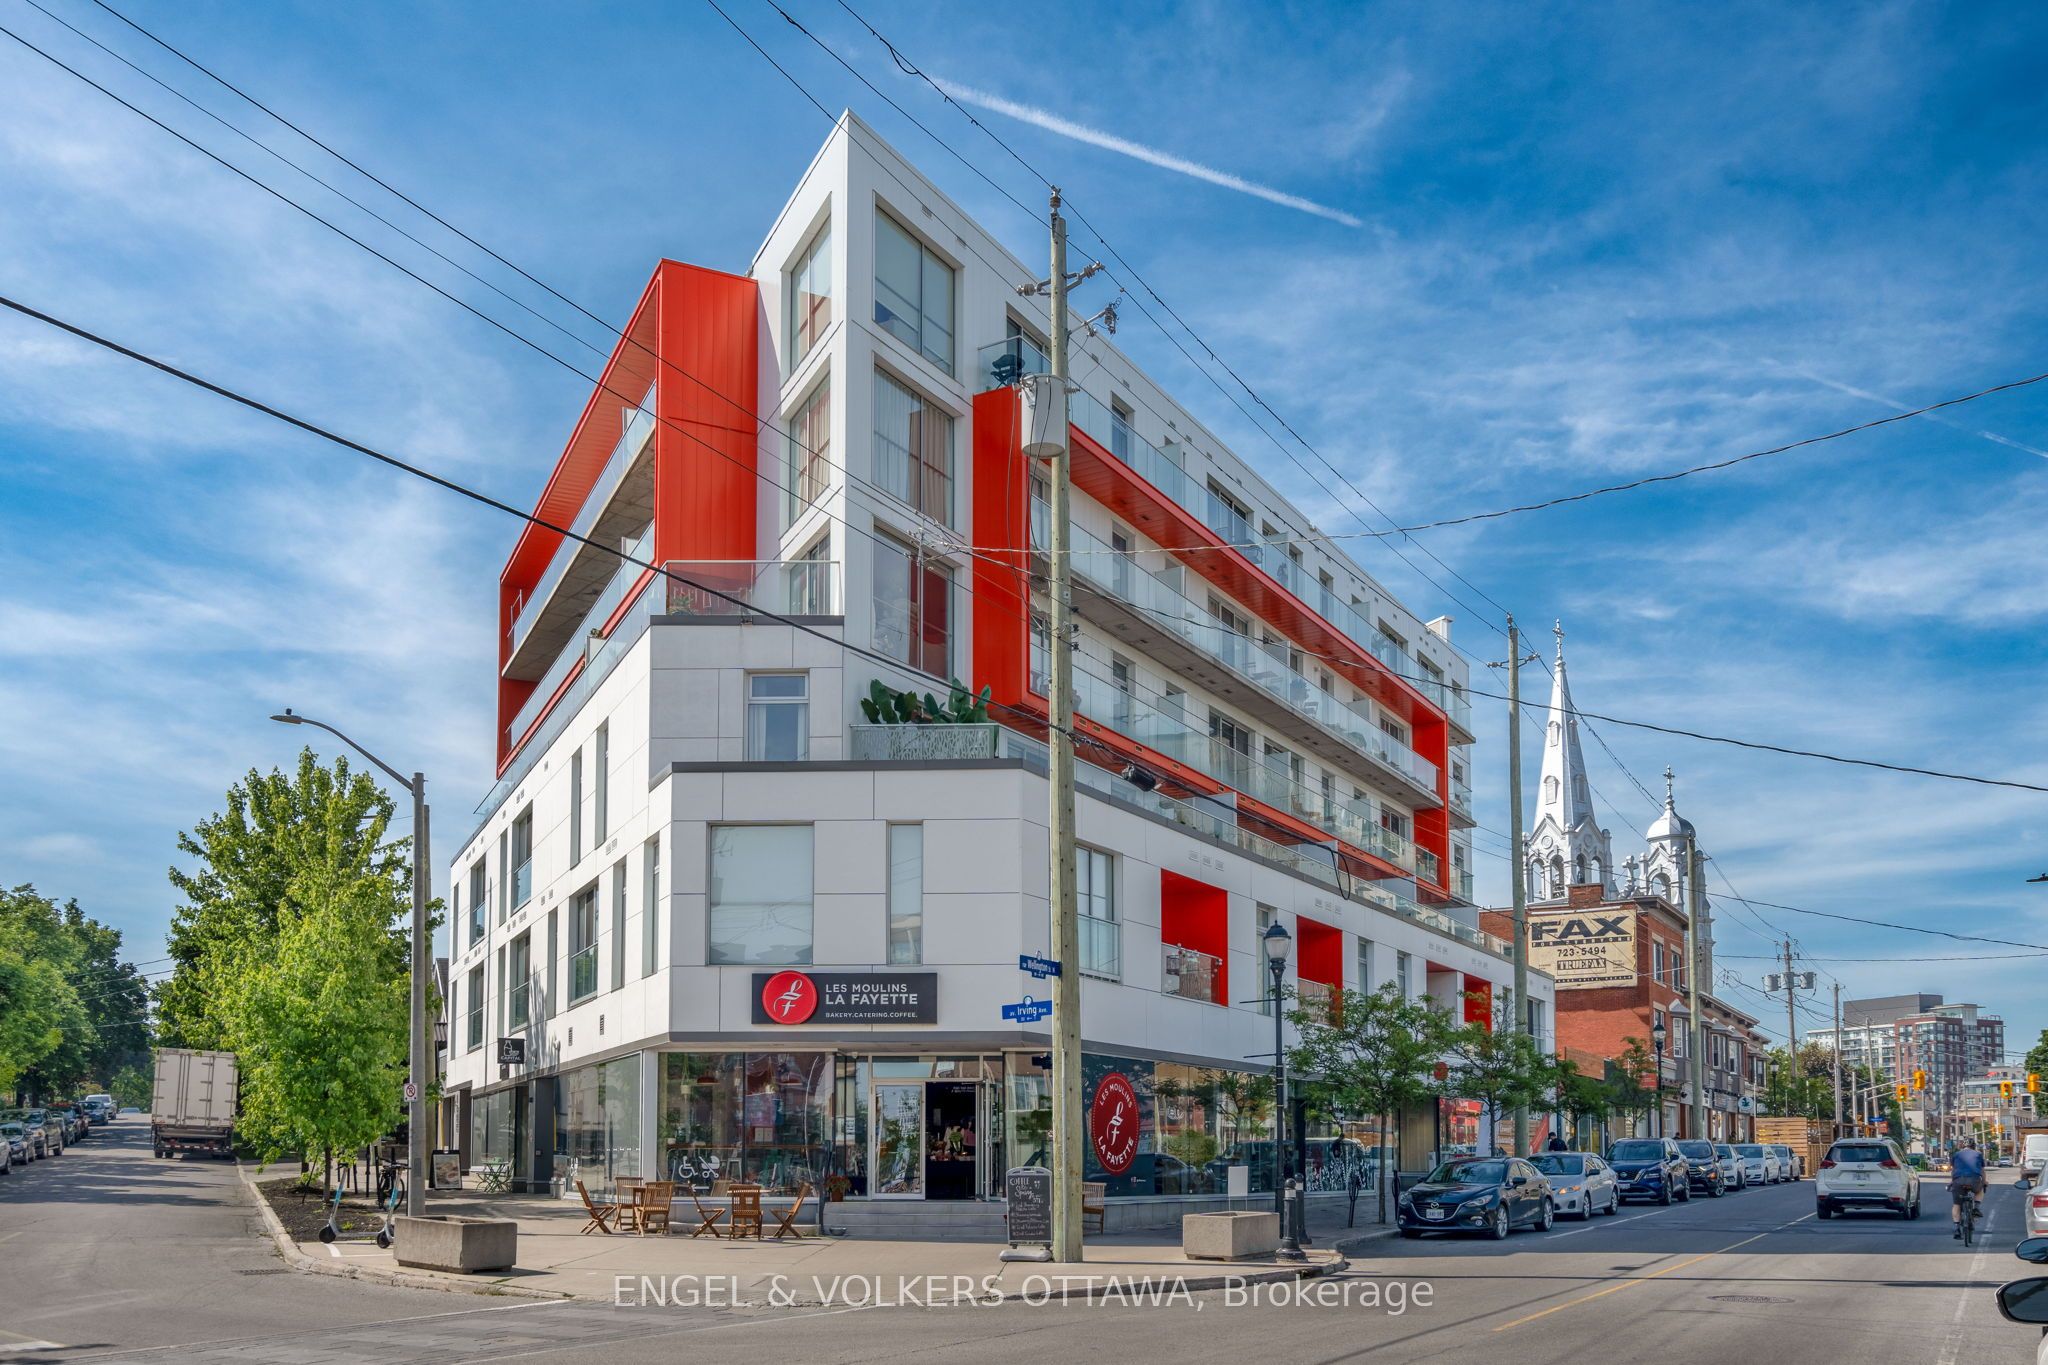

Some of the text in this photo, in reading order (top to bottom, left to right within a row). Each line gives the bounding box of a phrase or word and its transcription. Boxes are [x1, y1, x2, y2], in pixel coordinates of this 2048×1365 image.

[1532, 916, 1631, 940] FAX
[1557, 946, 1606, 957] 723-5494
[1557, 959, 1606, 970] TRUEFAX
[825, 984, 908, 993] LES MOULINS
[825, 994, 918, 1005] LA FAYETTE
[1017, 1006, 1037, 1017] Irving
[1100, 1083, 1133, 1108] LES MOULINS
[1098, 1135, 1134, 1165] LA FAYETTE
